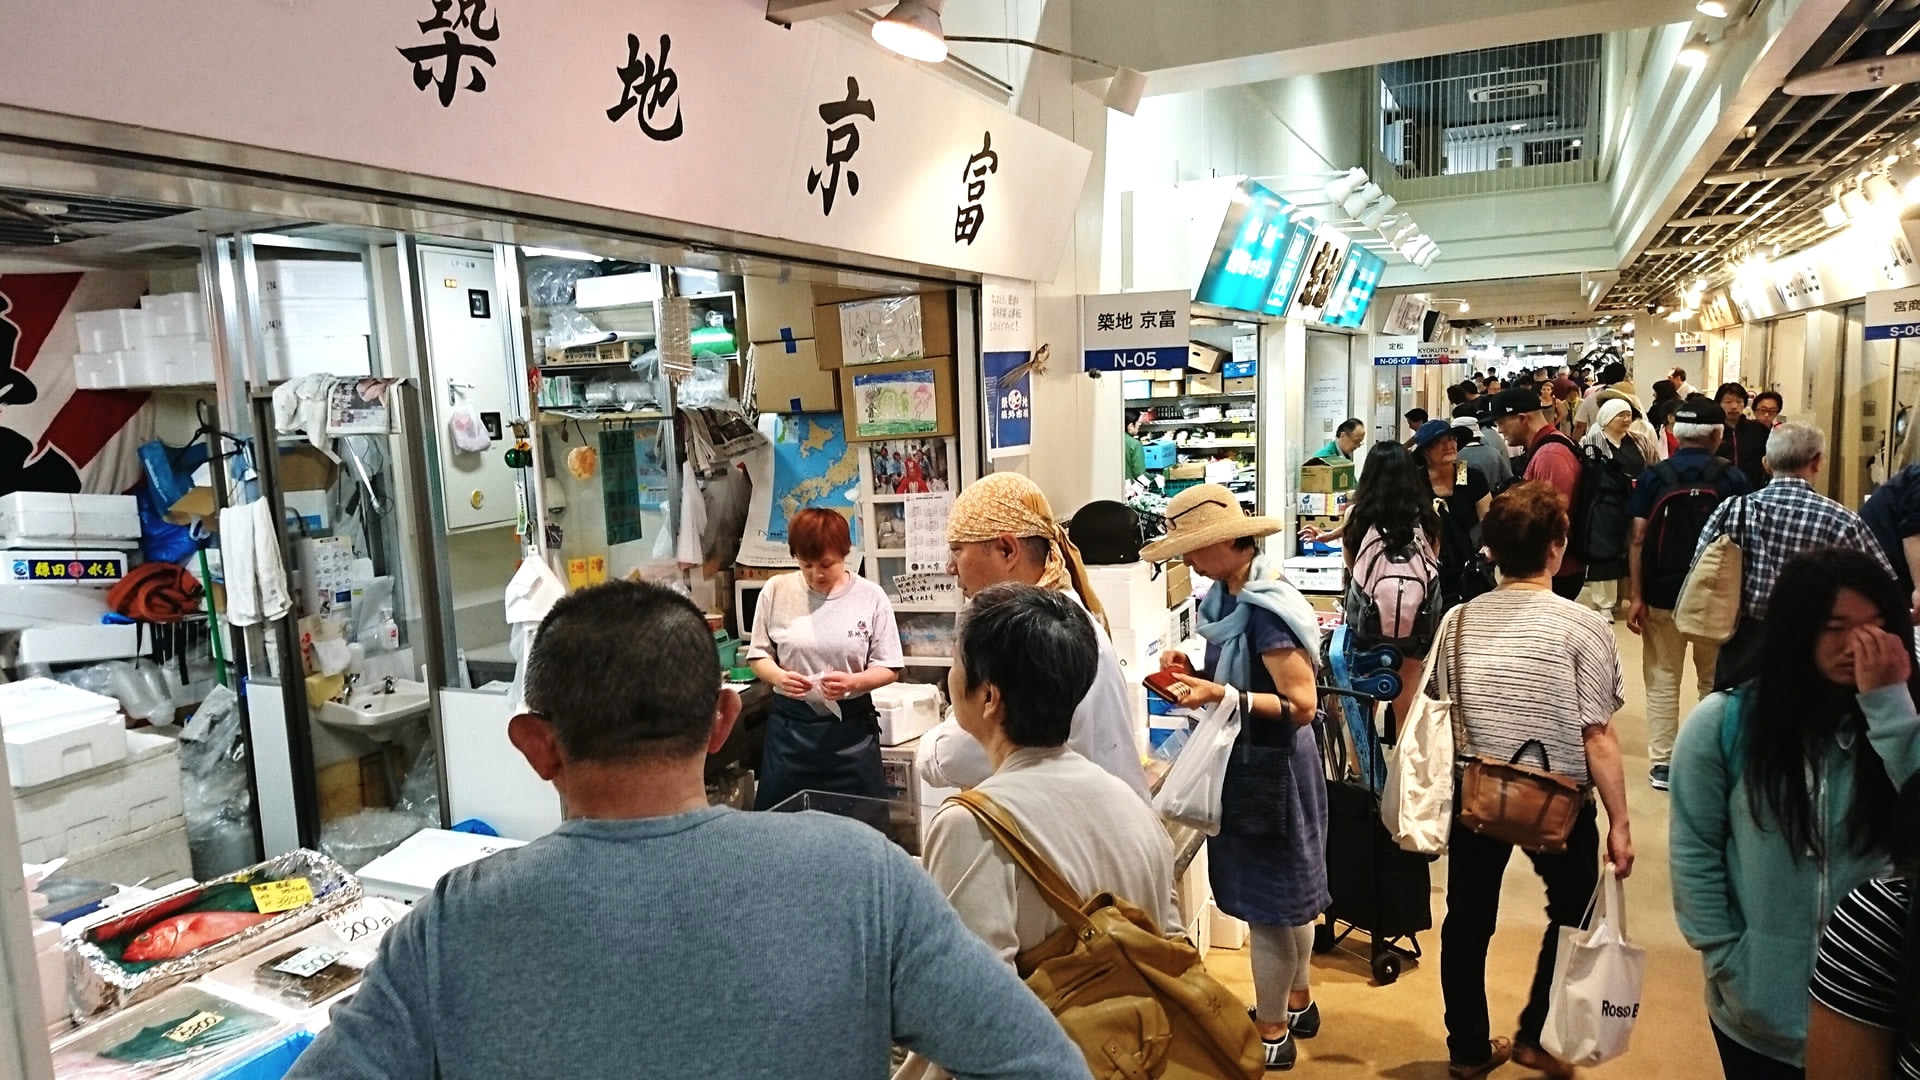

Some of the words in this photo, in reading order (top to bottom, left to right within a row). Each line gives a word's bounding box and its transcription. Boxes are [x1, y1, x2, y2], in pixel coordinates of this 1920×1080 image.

[1894, 299, 1920, 312] 宮商
[1097, 312, 1133, 331] 築地
[1140, 309, 1176, 329] 京富
[1114, 352, 1157, 367] N-05
[1602, 1000, 1630, 1018] Rosso
